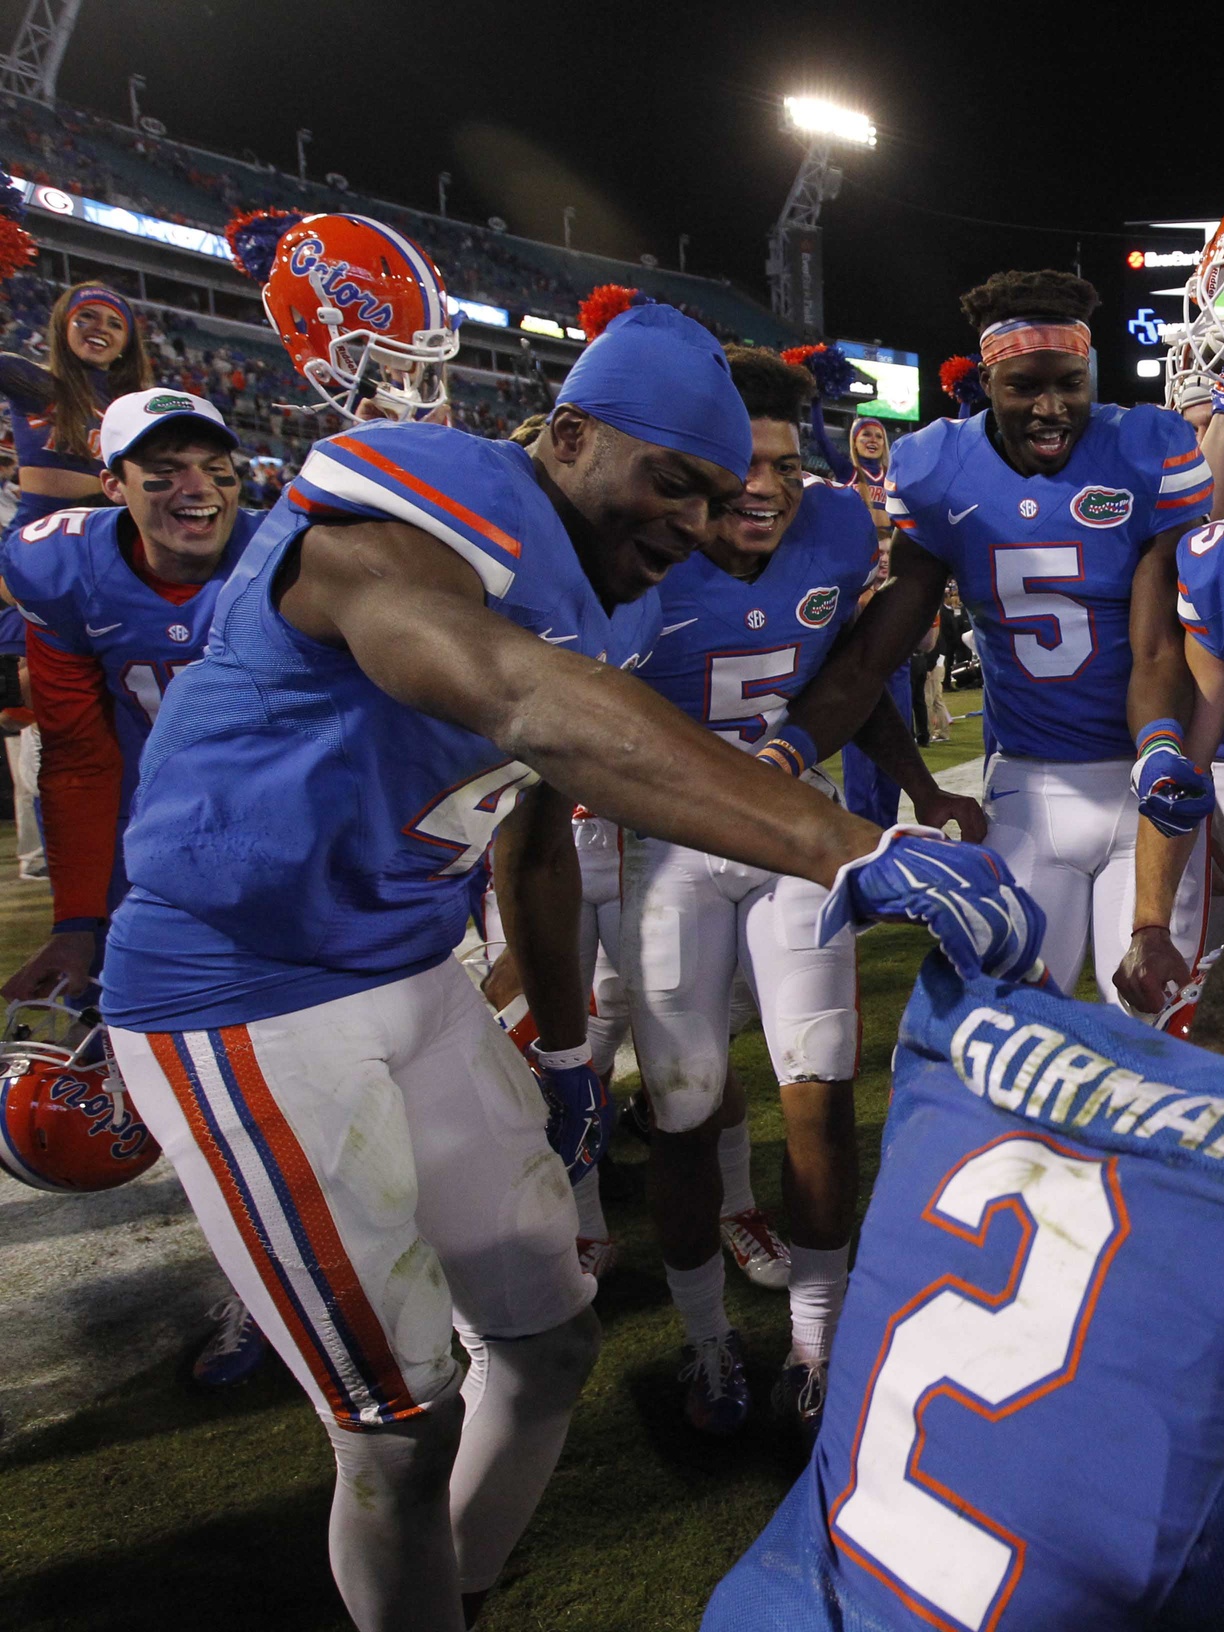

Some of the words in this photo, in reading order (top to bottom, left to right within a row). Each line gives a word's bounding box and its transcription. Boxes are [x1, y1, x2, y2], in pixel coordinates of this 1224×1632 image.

[1019, 500, 1038, 518] SEC
[168, 625, 190, 640] SEC
[746, 609, 766, 629] SEC
[990, 542, 1099, 683] 5
[703, 642, 800, 758] 5
[51, 1075, 150, 1160] Gators
[828, 1130, 1131, 1632] 2
